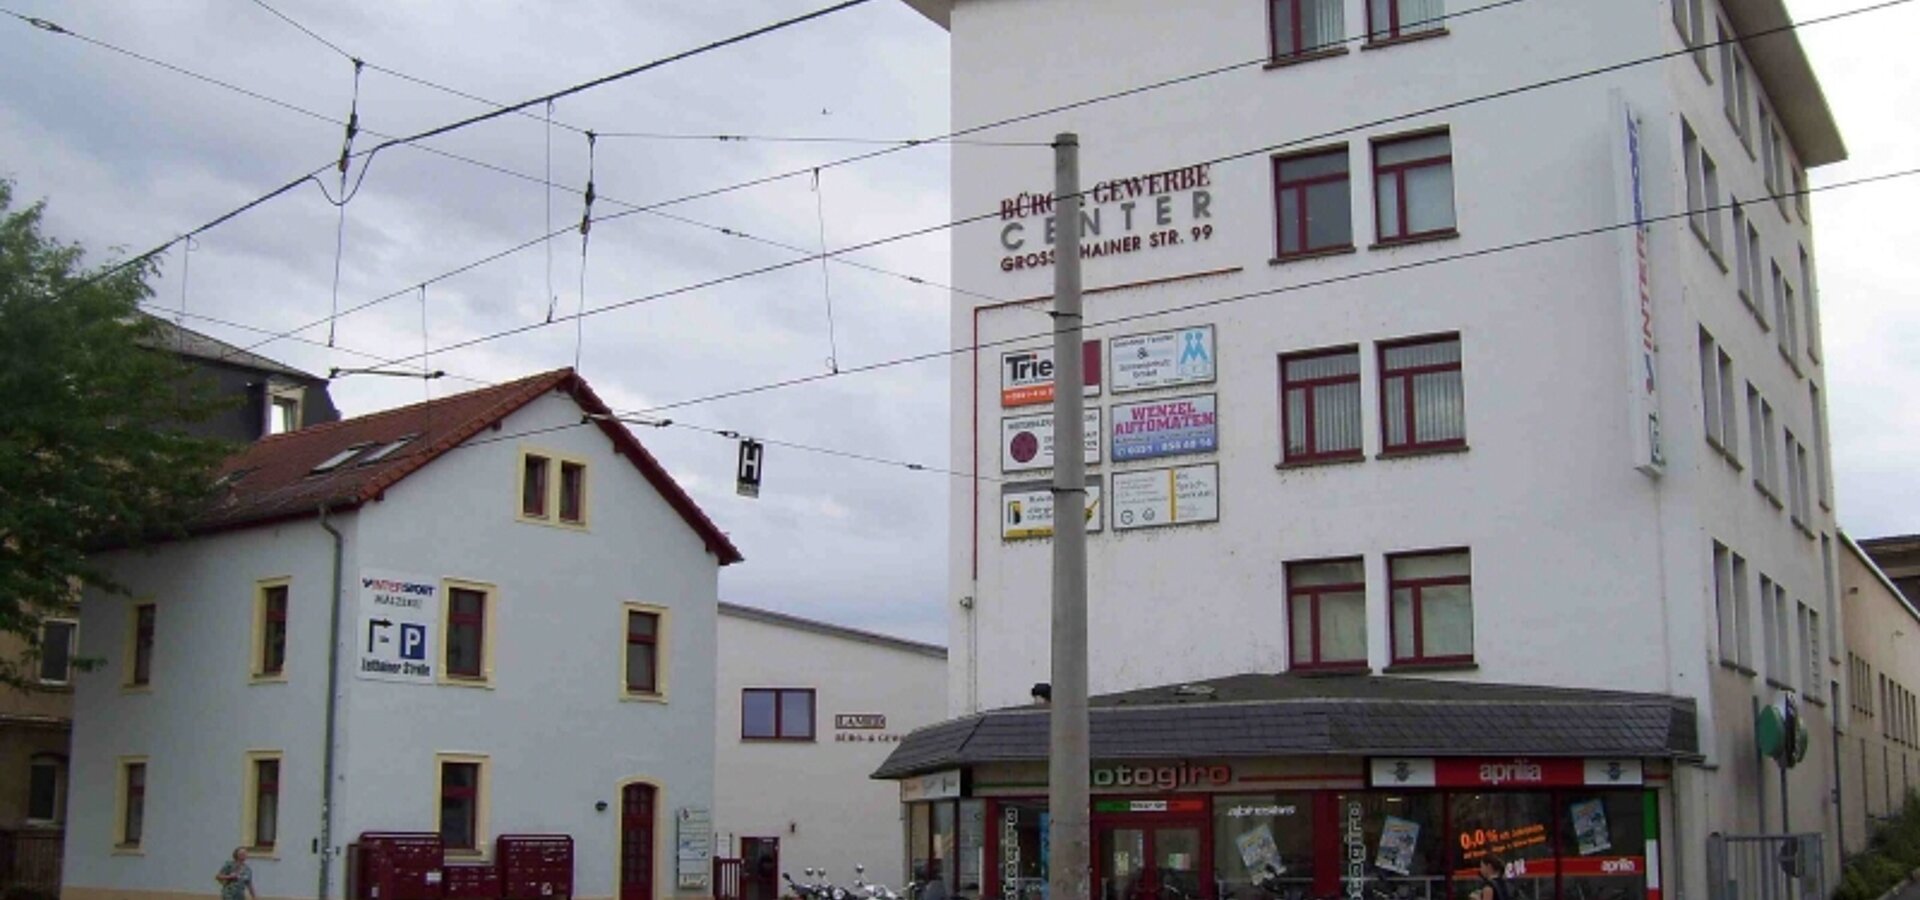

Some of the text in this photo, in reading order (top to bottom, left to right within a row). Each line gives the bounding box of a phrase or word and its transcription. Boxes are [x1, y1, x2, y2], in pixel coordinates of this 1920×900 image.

[1093, 163, 1212, 204] GEWERBE
[1000, 191, 1213, 251] CENTER
[1000, 225, 1213, 273] GROSSHAINER STR. 99
[1136, 347, 1149, 360] &
[1115, 411, 1215, 436] AUTOMATEN
[1131, 402, 1196, 421] WENZEL
[740, 446, 760, 480] H
[405, 627, 421, 656] P
[1093, 760, 1230, 789] otogiro
[1479, 757, 1542, 785] aprilia
